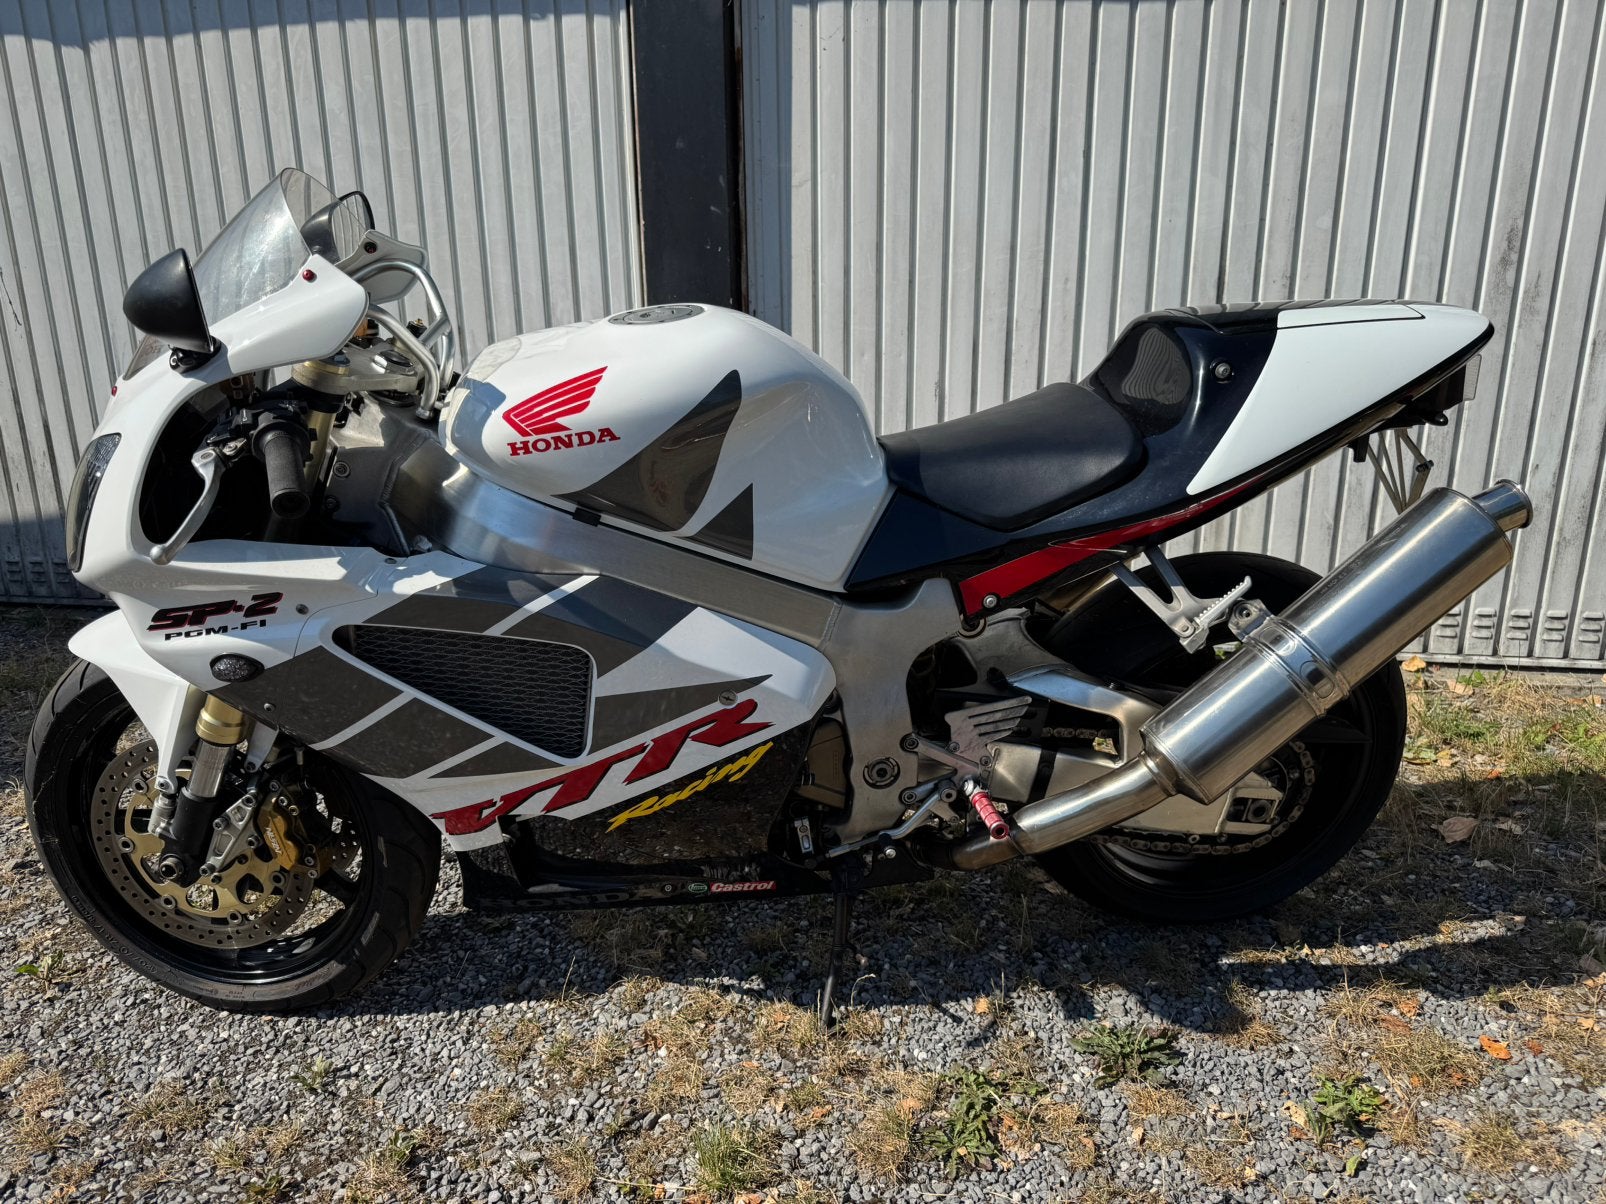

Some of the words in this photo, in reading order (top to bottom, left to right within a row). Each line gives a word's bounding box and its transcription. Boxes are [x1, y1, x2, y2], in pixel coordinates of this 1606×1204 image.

[508, 427, 621, 457] HONDA
[147, 592, 283, 631] SP-2
[165, 619, 267, 641] PGM-FI
[429, 699, 775, 835] VTR
[606, 741, 774, 833] Racing
[711, 881, 774, 893] Castrol
